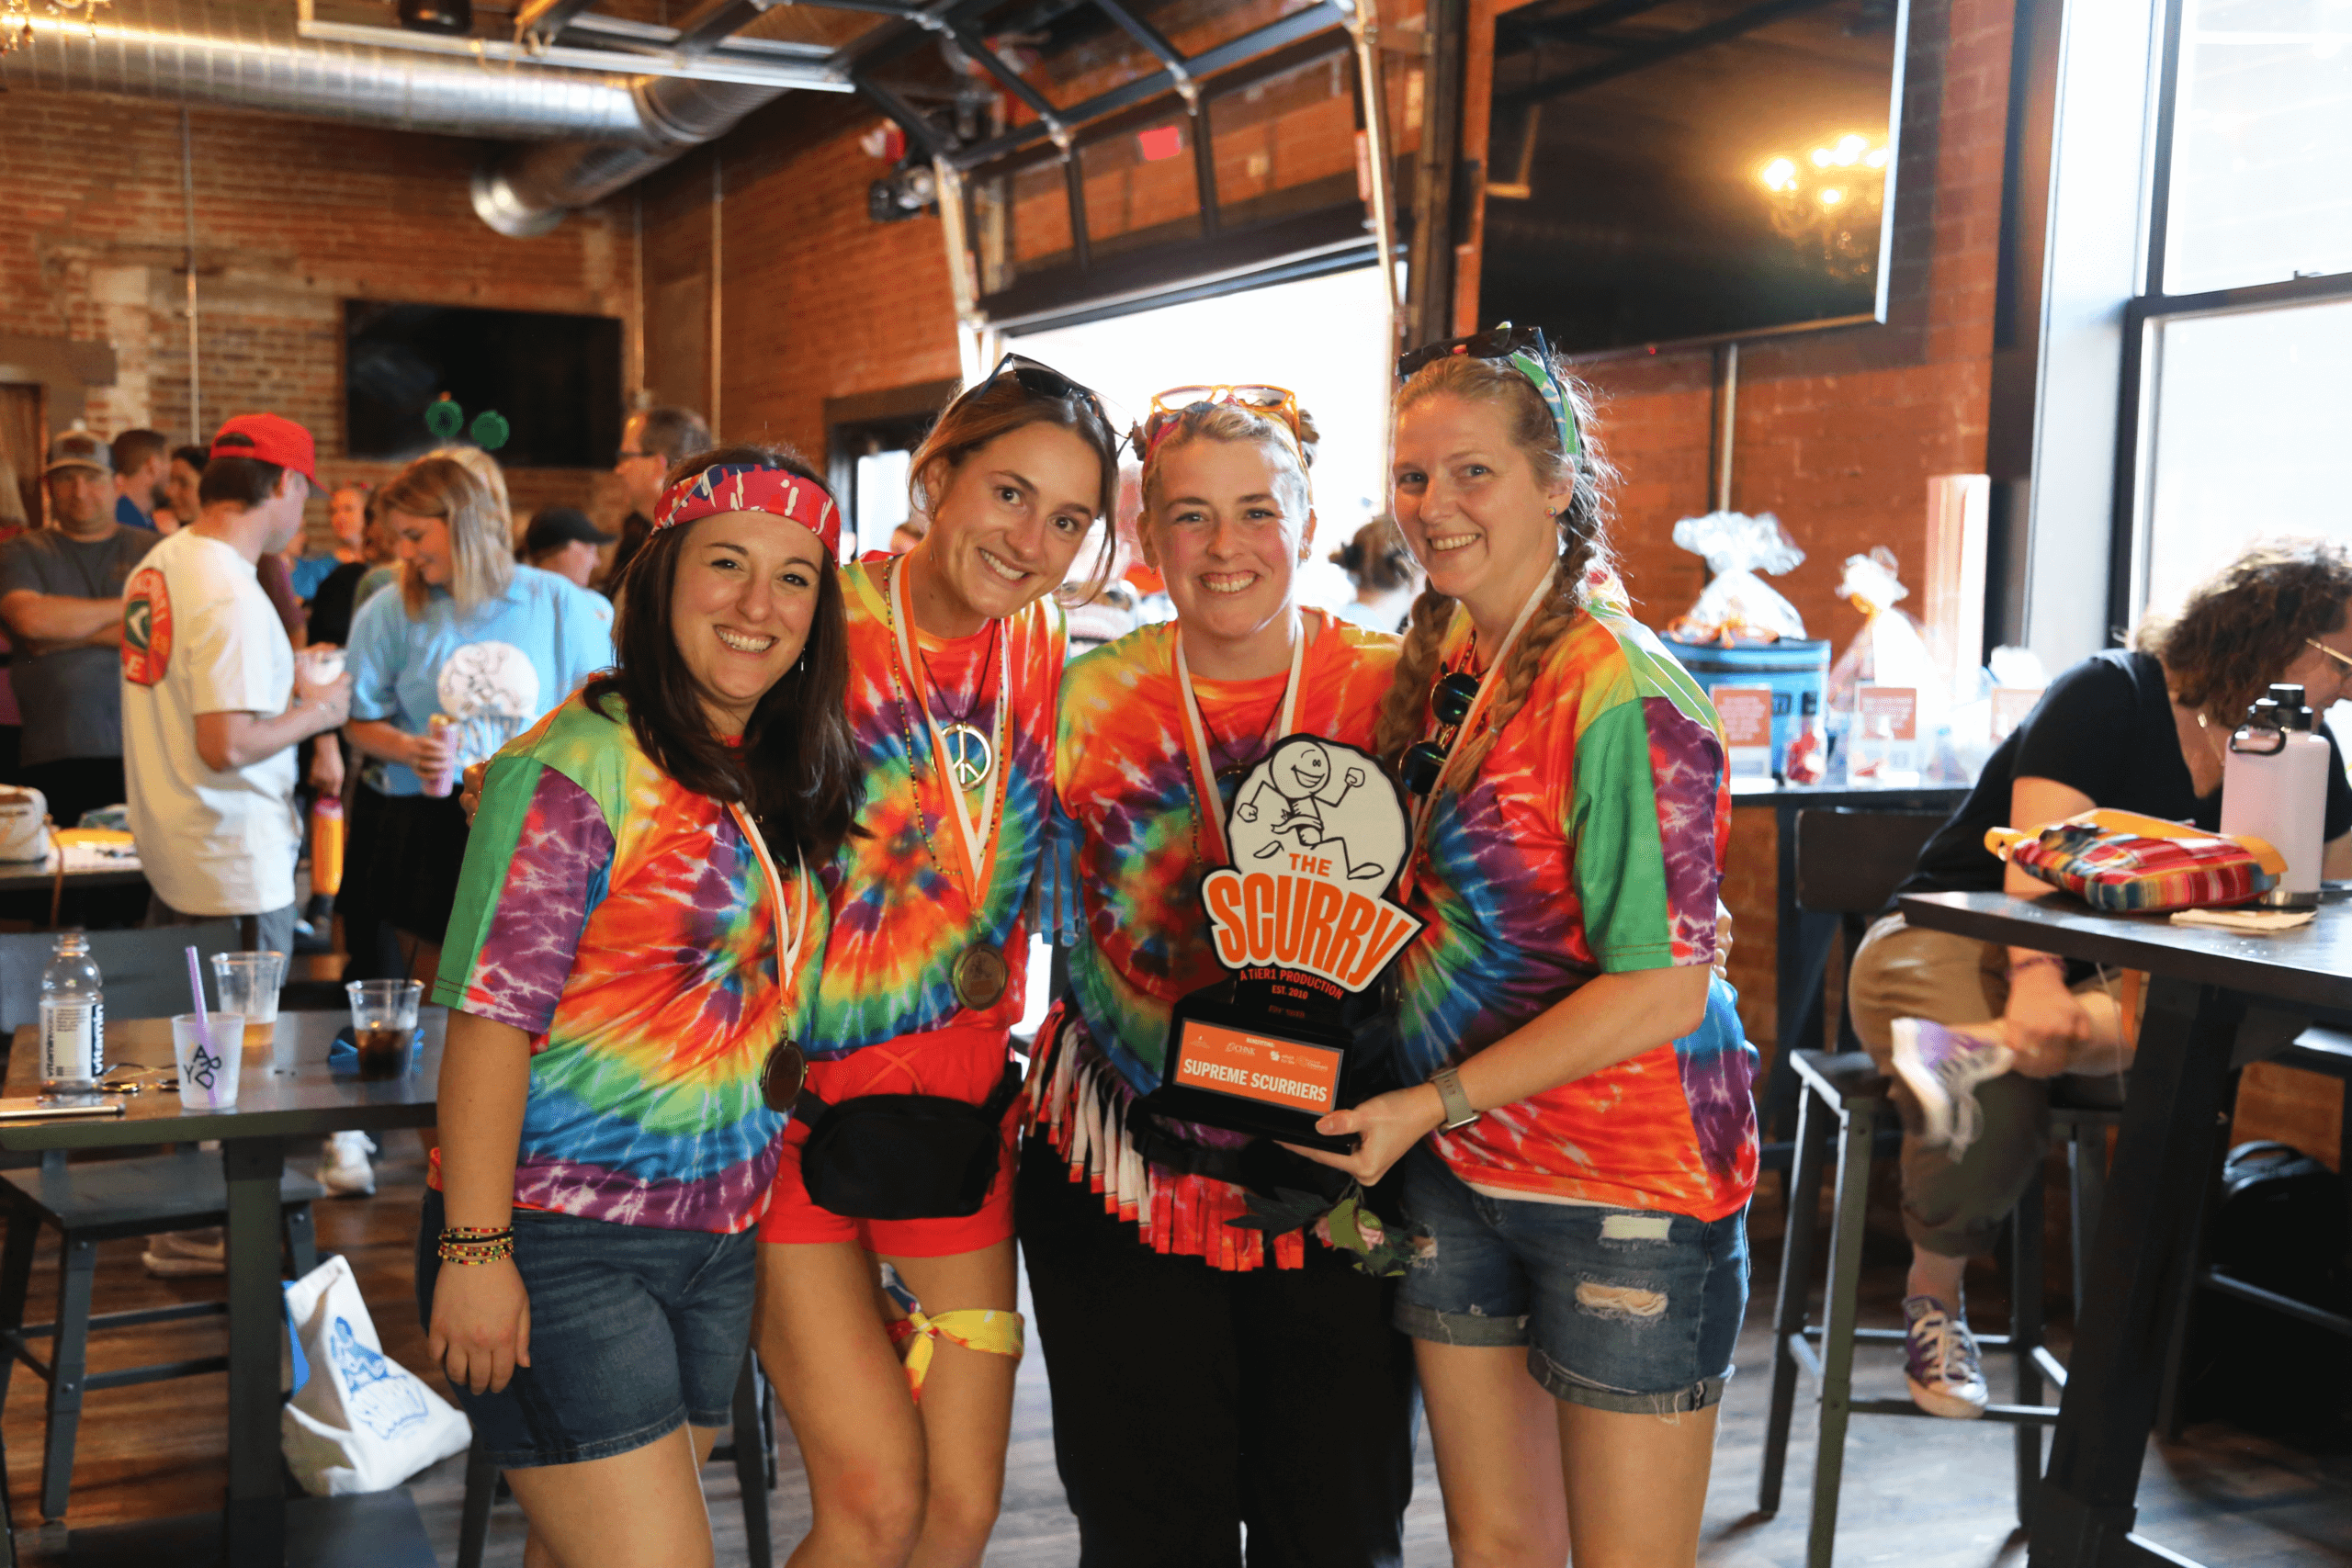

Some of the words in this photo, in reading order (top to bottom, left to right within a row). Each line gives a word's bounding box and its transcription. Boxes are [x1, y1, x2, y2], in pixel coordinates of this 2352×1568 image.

[1288, 852, 1332, 878] THE
[1207, 873, 1413, 987] SCURRY
[1239, 969, 1248, 982] A
[1279, 969, 1344, 1000] PRODUCTION
[1272, 985, 1287, 995] EST.
[1288, 987, 1309, 999] 2010
[1183, 1058, 1249, 1086] SUPREME
[1250, 1072, 1328, 1102] SCURRIERS
